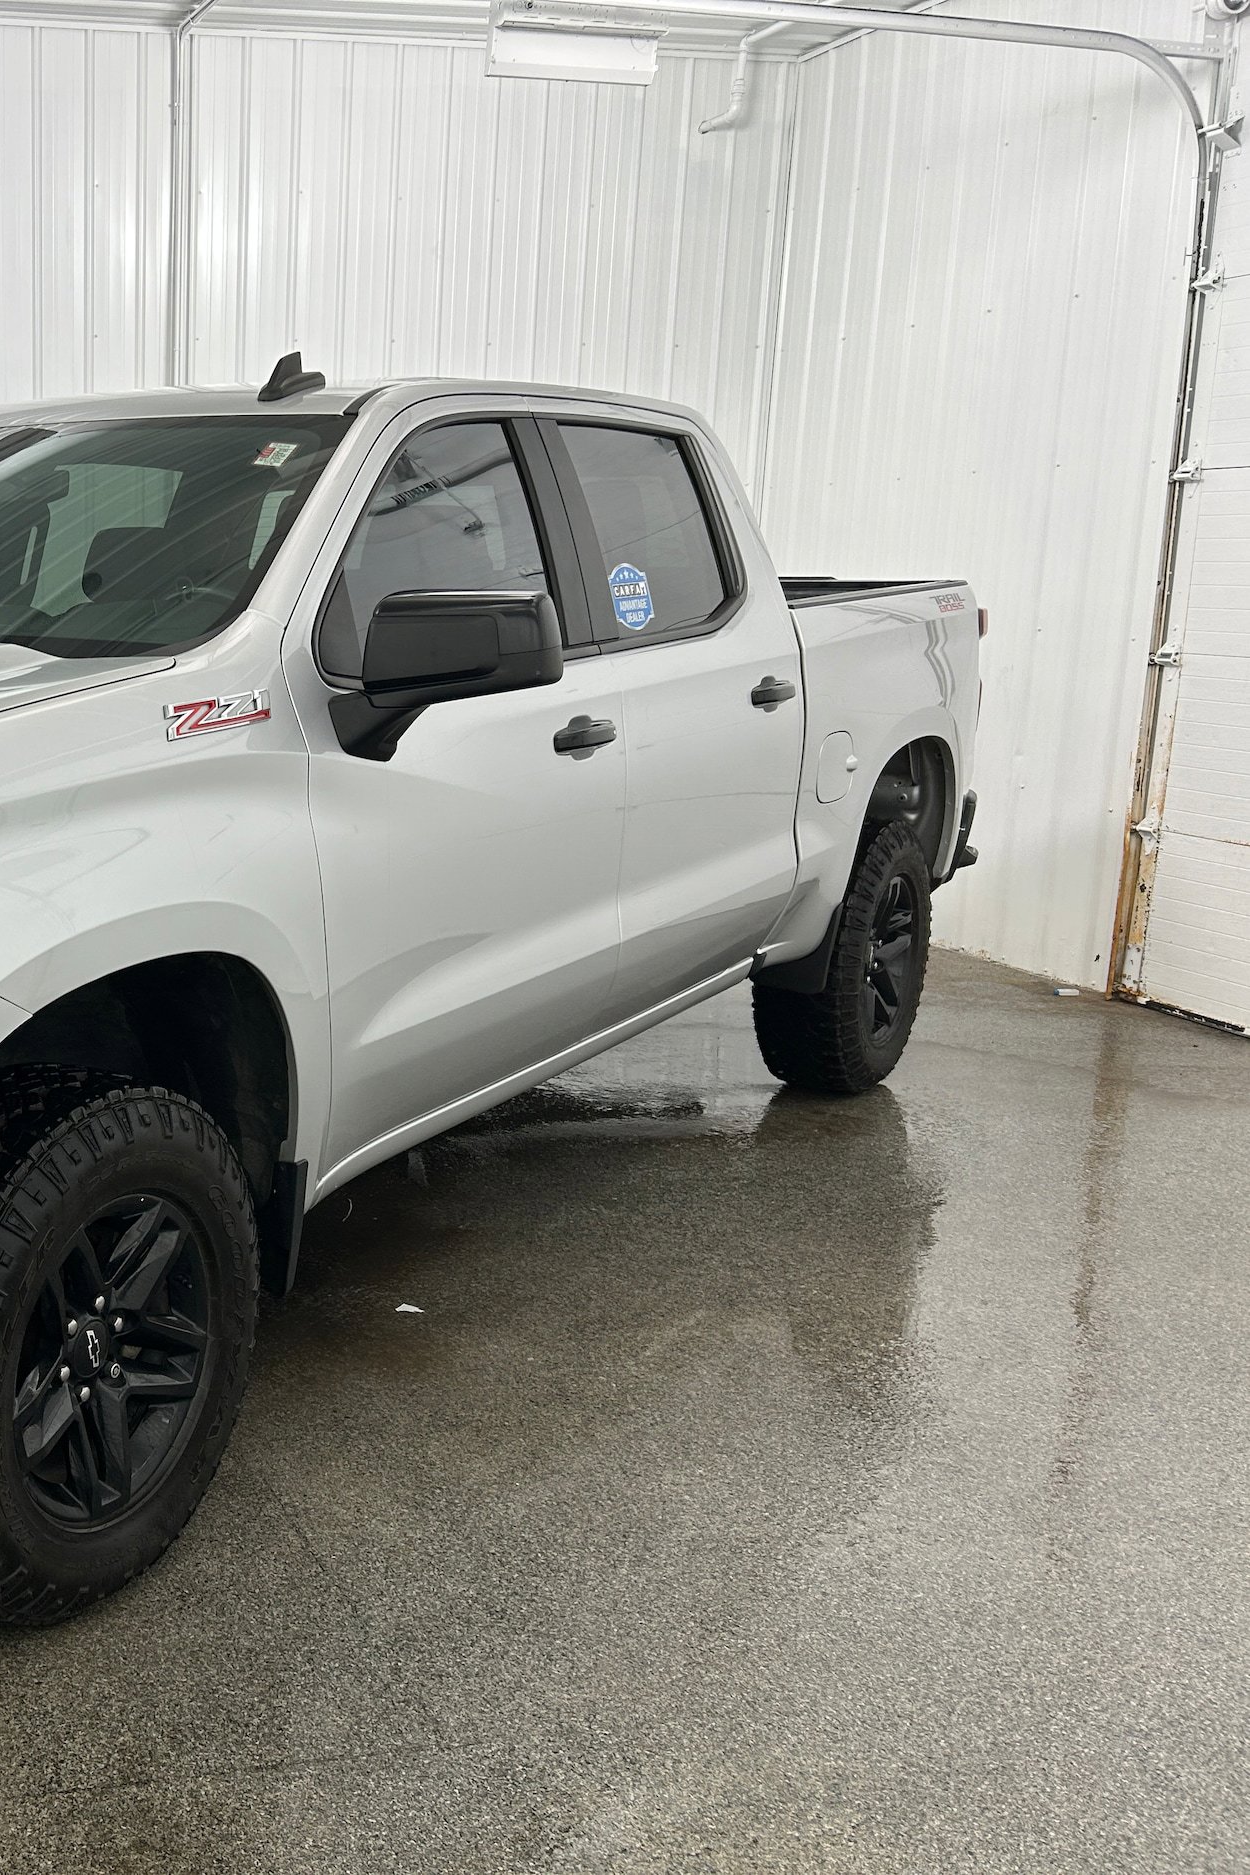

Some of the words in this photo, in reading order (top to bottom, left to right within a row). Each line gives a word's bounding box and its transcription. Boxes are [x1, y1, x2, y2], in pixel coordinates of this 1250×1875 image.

[619, 598, 649, 612] ADVANTAGE
[929, 592, 966, 605] TRAIL
[938, 601, 966, 613] BOSS
[626, 610, 646, 624] DEALER
[163, 688, 271, 742] Z71
